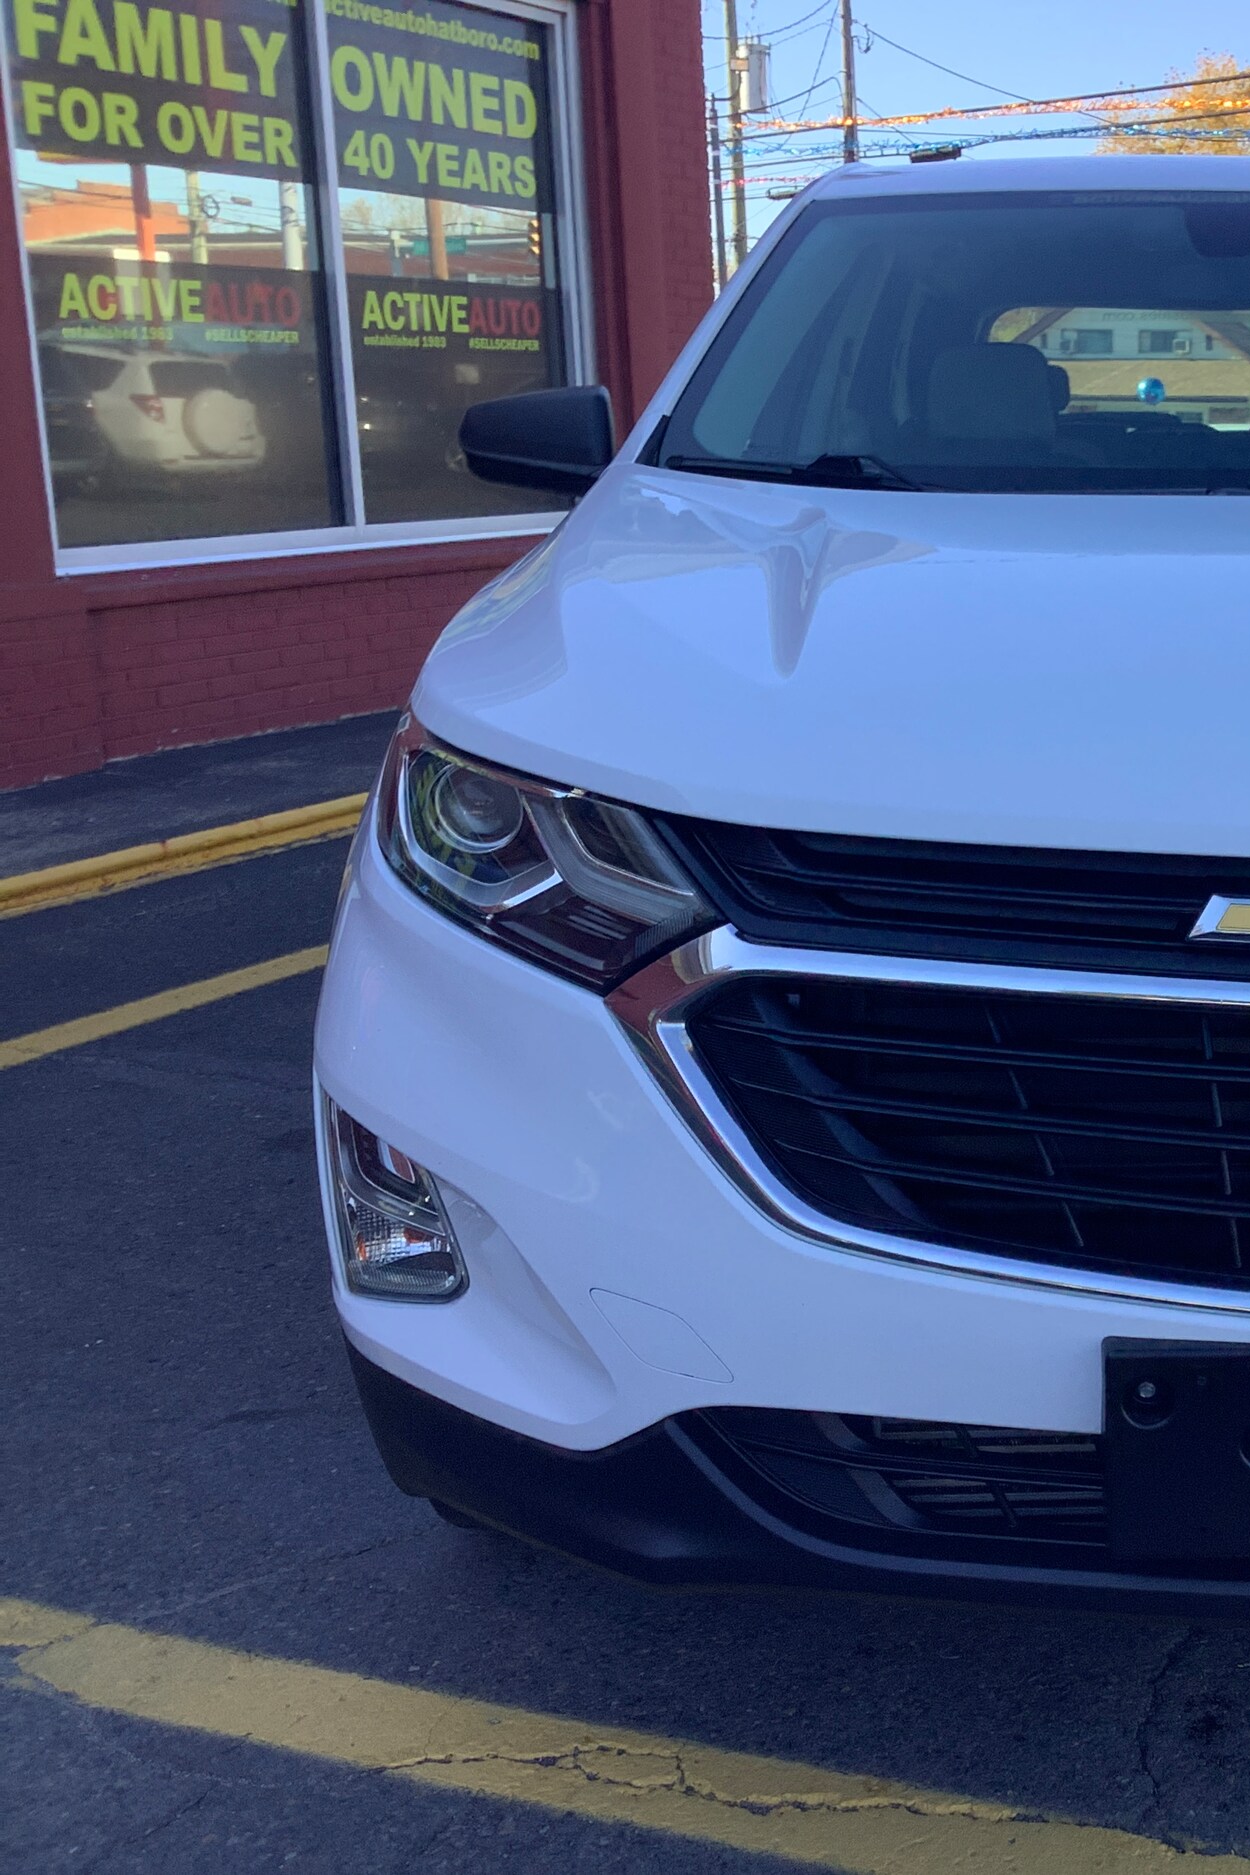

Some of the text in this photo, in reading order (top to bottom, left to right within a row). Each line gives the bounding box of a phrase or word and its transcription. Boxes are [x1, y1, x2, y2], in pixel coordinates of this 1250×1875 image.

[13, 0, 287, 98] FAMILY
[331, 45, 537, 139] OWNED
[22, 80, 298, 168] FOR OVER
[343, 130, 537, 198] 40 YEARS
